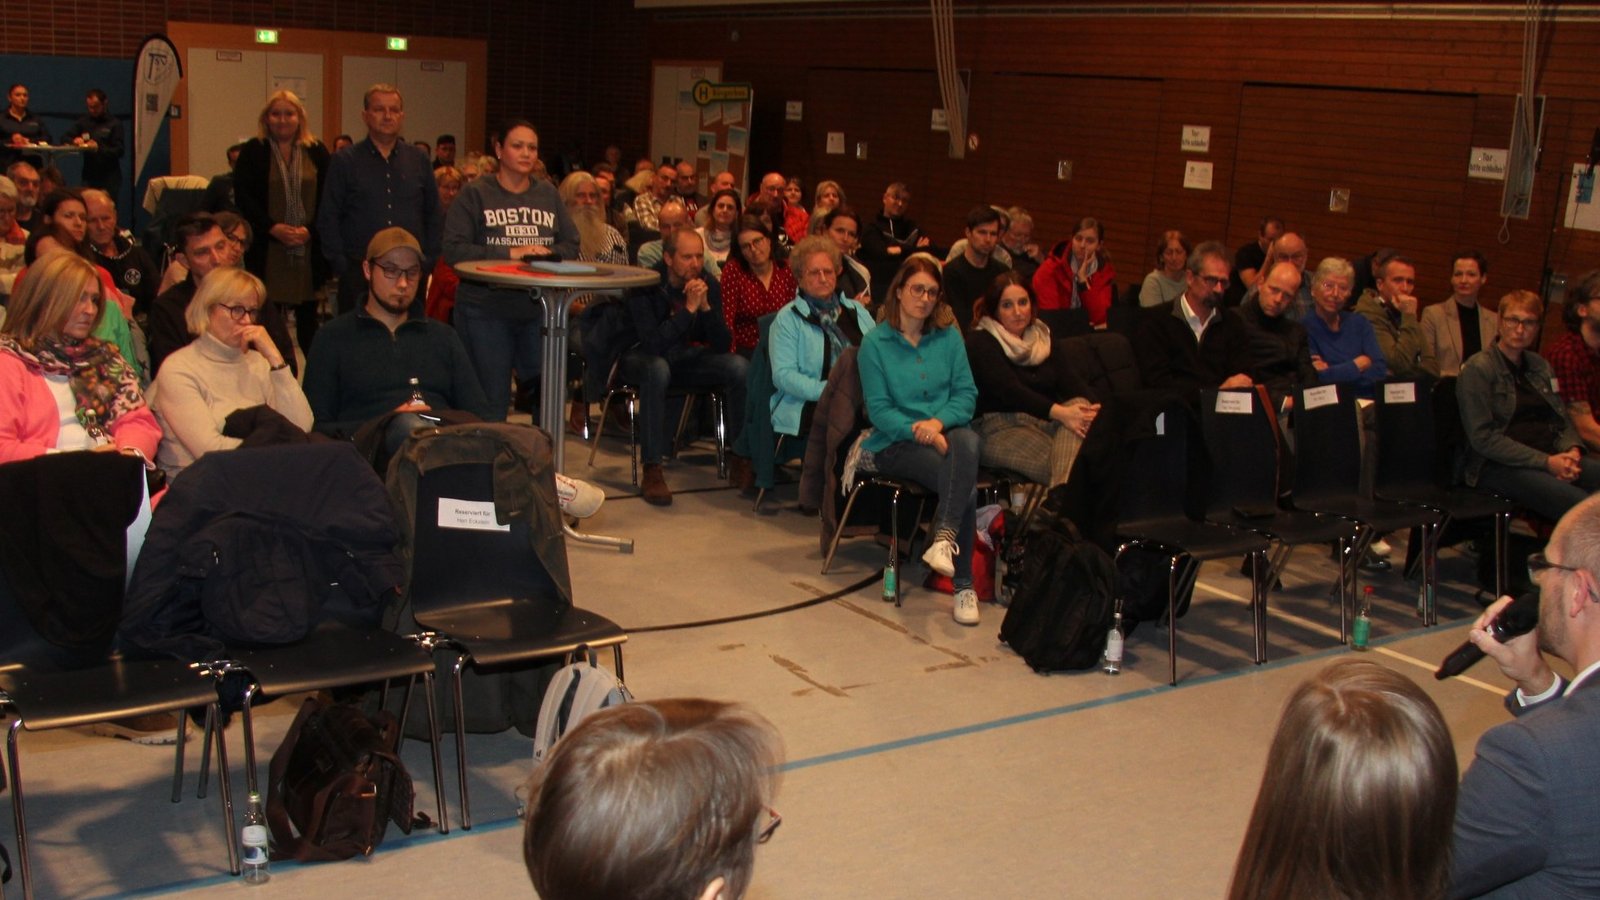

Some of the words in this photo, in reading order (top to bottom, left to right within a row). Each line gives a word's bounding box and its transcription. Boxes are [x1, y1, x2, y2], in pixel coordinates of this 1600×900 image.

[699, 87, 708, 100] H
[1482, 152, 1493, 162] Tor
[484, 207, 555, 229] BOSTON
[507, 226, 536, 235] 1630
[454, 508, 482, 516] Reserviert
